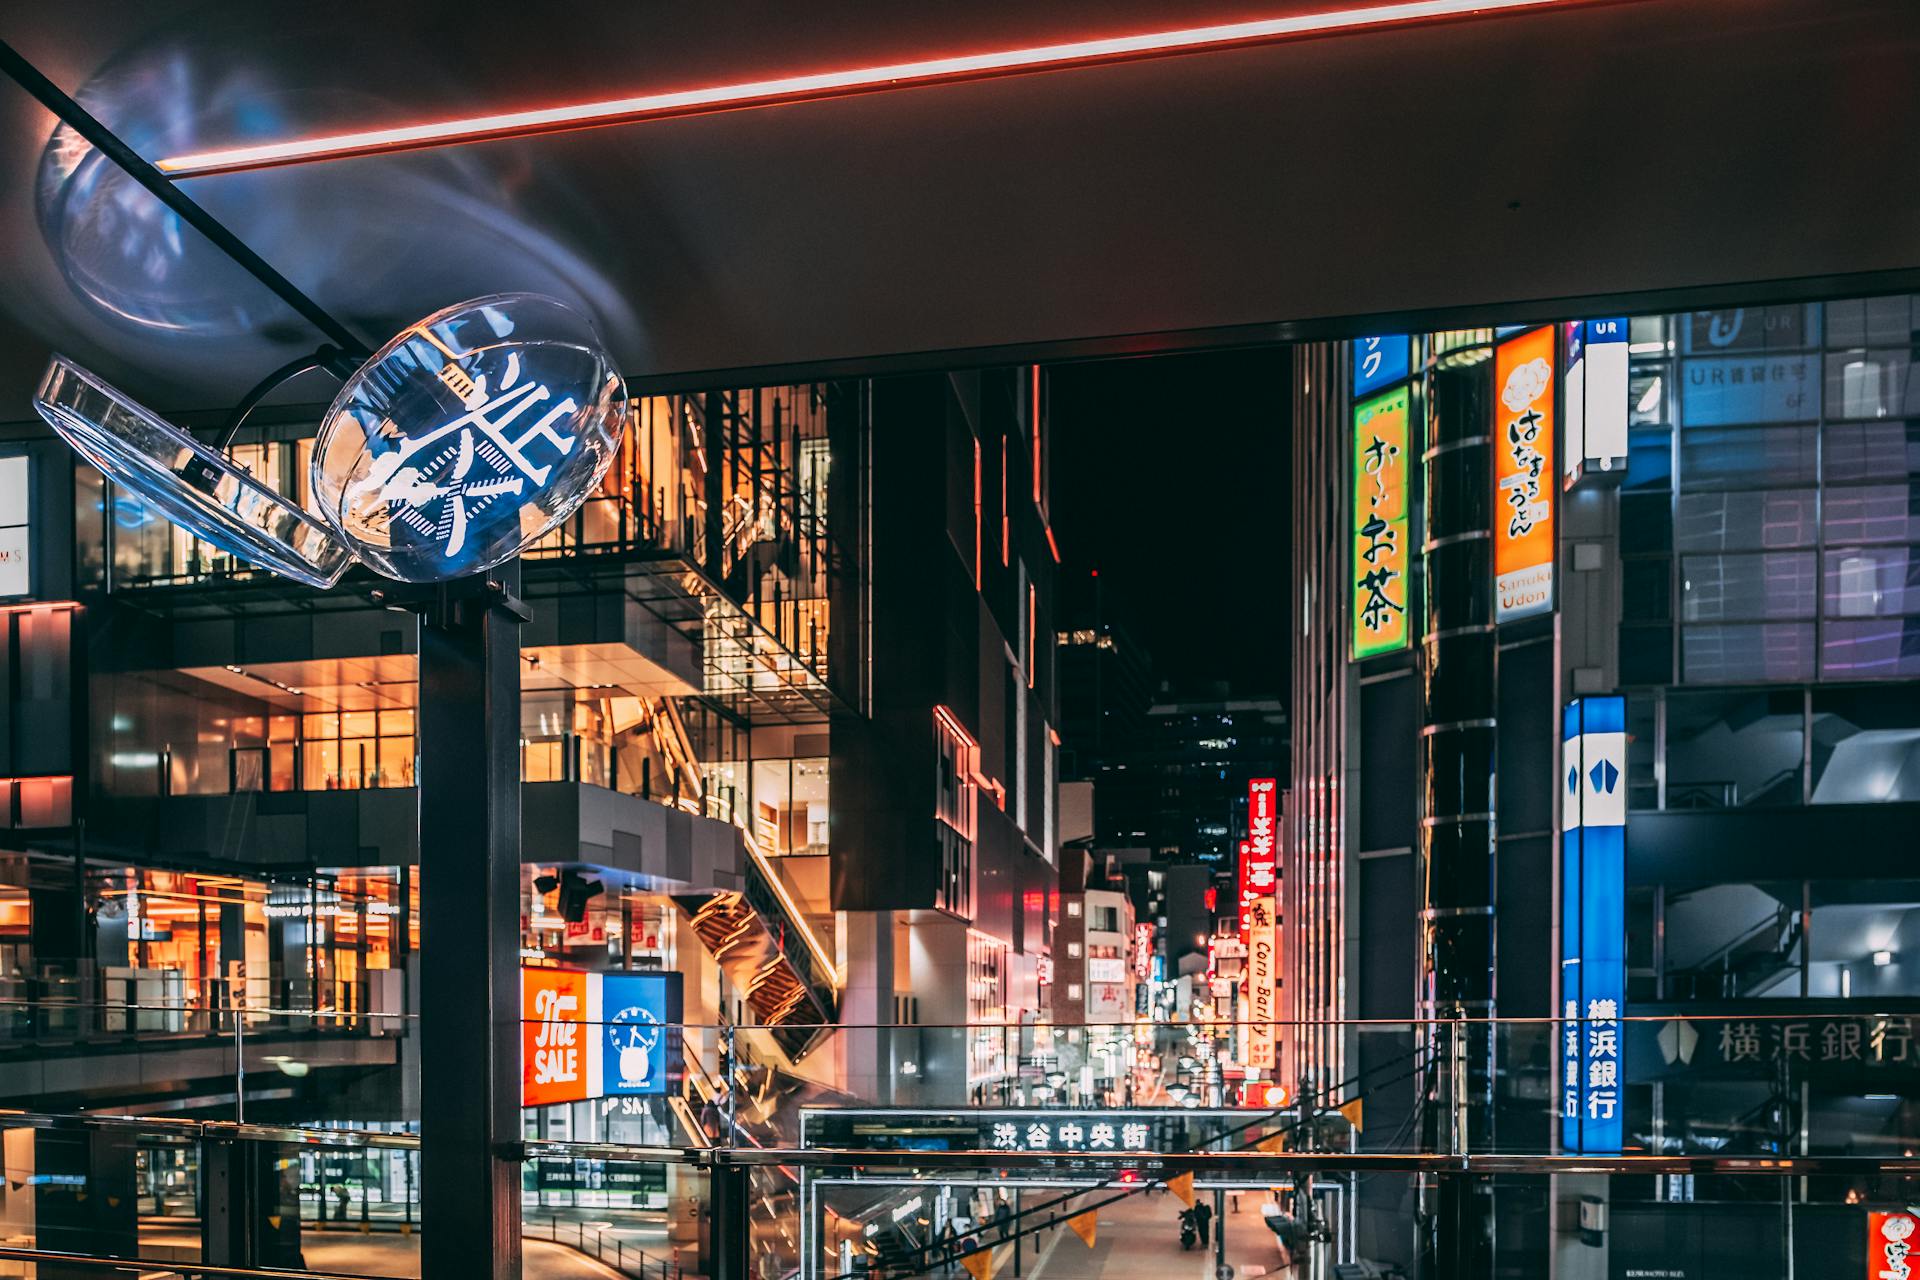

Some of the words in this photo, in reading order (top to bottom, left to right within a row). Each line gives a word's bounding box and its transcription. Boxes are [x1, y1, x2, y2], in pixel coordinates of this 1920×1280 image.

[1595, 321, 1617, 334] UR
[1503, 592, 1546, 609] Udon
[1252, 941, 1272, 1037] Corn-Barly
[535, 989, 577, 1047] The
[1587, 999, 1617, 1119] 横浜銀行
[1719, 1018, 1913, 1062] 横浜銀行
[535, 1049, 577, 1085] SALE
[992, 1122, 1148, 1149] 渋谷中央街
